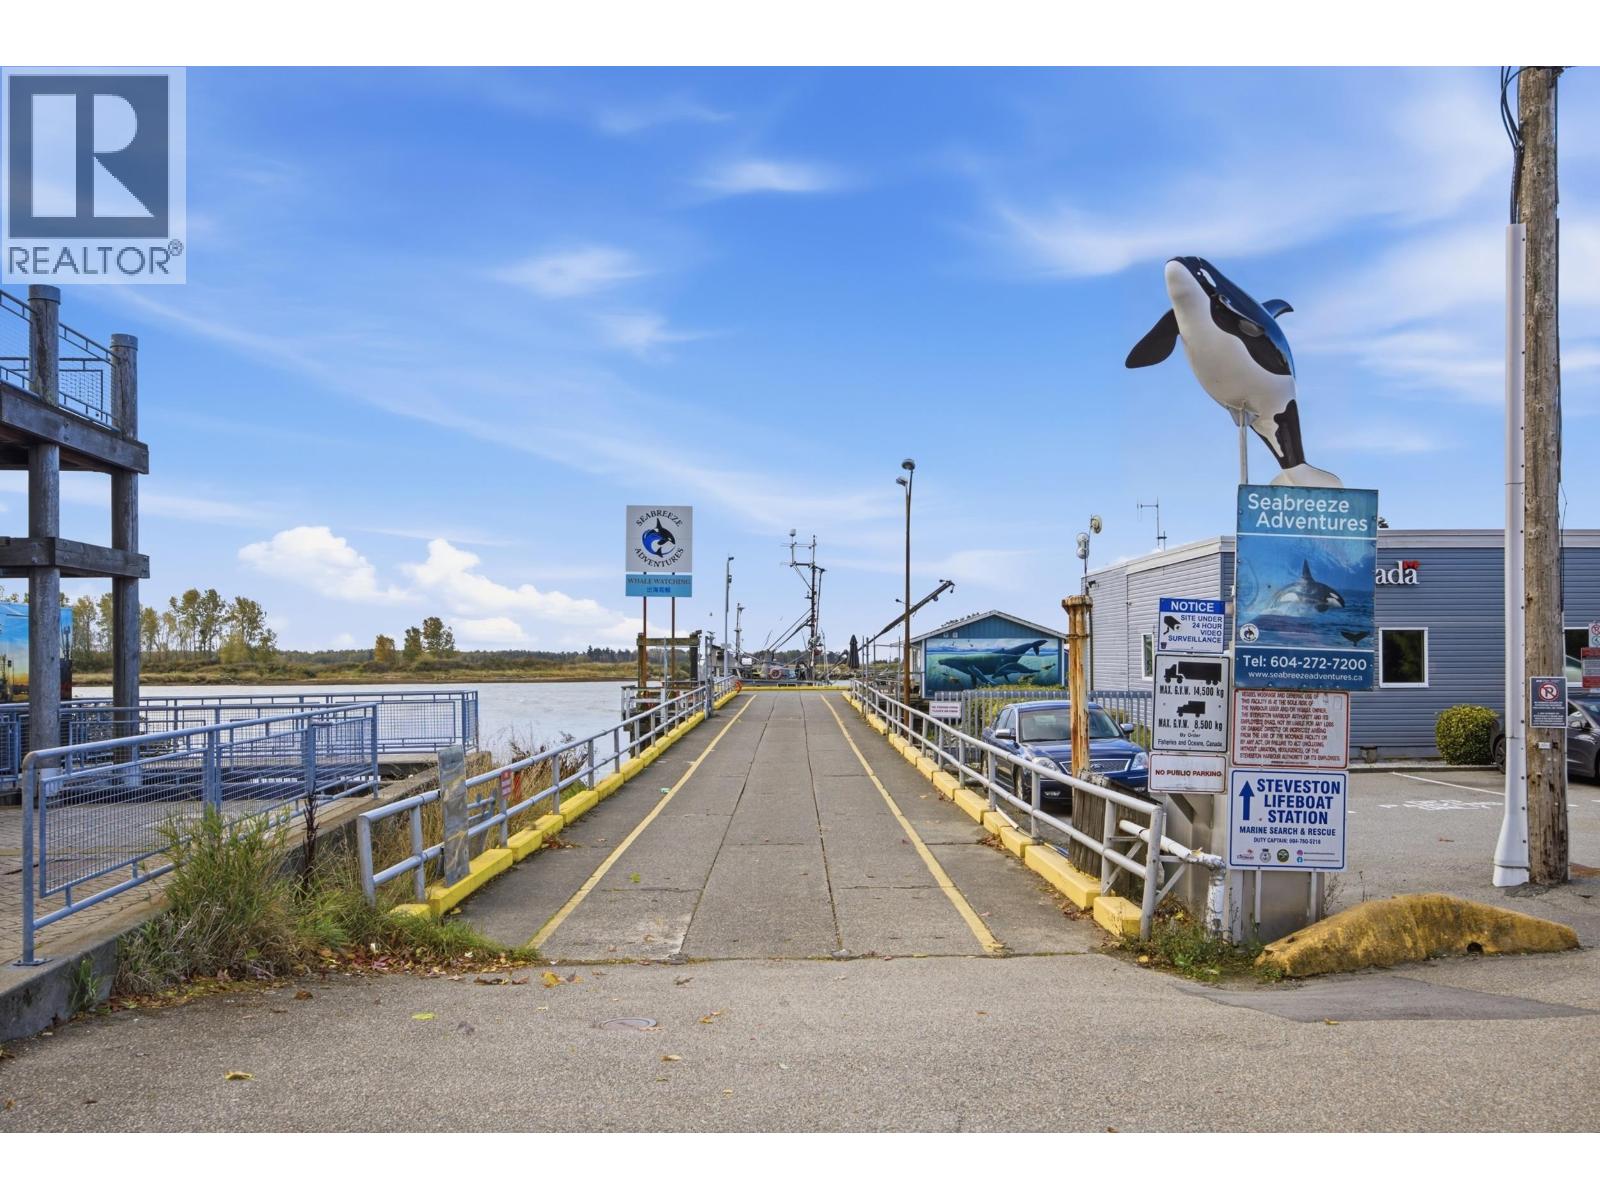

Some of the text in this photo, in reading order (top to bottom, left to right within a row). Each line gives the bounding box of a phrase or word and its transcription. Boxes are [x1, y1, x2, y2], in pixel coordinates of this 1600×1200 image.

[1248, 493, 1349, 512] Seabreeze
[636, 510, 683, 527] SEABREEZE
[1256, 512, 1368, 531] Adventures
[635, 548, 684, 568] ADVENTURES
[1171, 601, 1214, 612] NOTICE
[1243, 655, 1367, 670] Tel: 604-272-7200
[1248, 671, 1362, 680] www.seabreezeadventures.ca
[1160, 685, 1172, 694] MAX.
[1194, 687, 1213, 696] 14,500
[1217, 688, 1224, 698] kg
[1158, 718, 1171, 728] MAX.
[1215, 721, 1222, 731] kg
[1257, 779, 1340, 794] STEVESTON
[1264, 795, 1333, 809] LIFEBOAT
[1268, 810, 1328, 824] STATION
